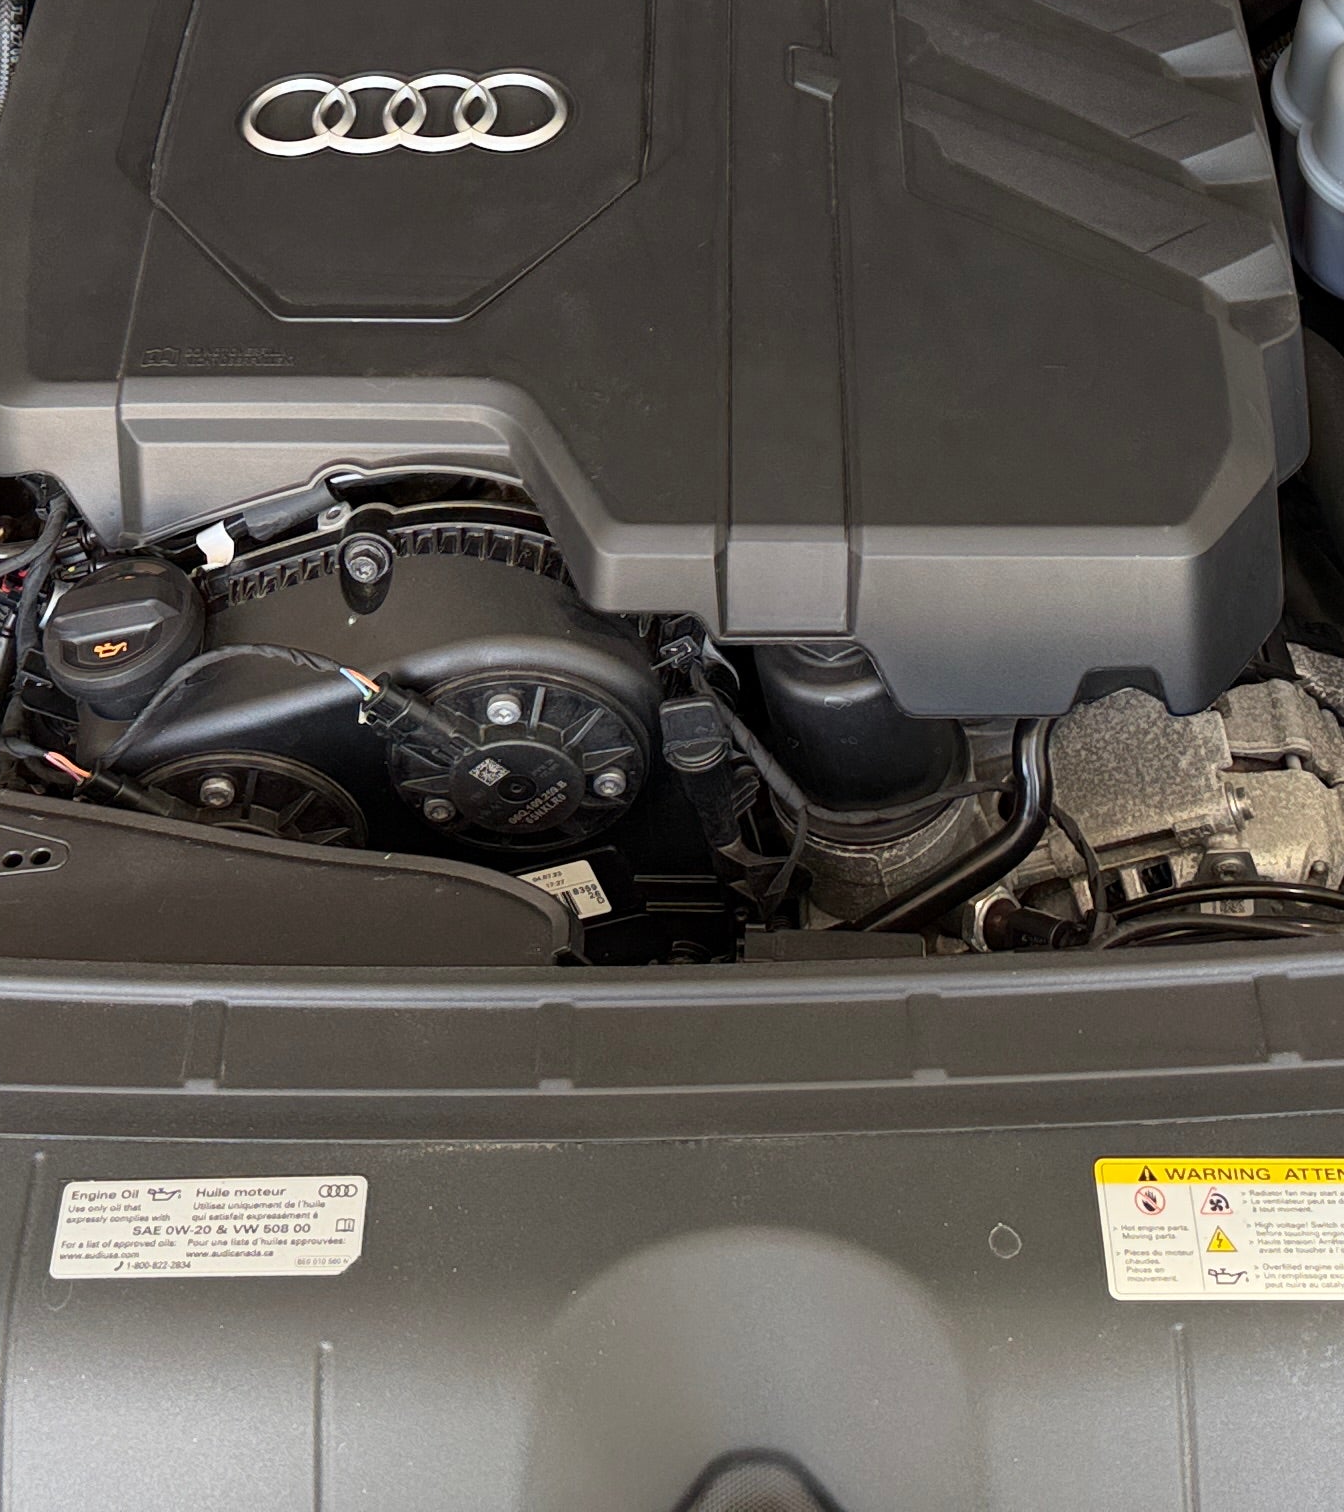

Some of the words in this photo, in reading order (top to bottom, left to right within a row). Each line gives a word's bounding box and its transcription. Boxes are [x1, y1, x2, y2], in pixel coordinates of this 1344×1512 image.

[1164, 1168, 1271, 1180] WARNING
[71, 1190, 117, 1202] Engine
[121, 1189, 139, 1199] Oil
[196, 1188, 230, 1197] Huile
[234, 1188, 286, 1197] moteur
[68, 1204, 85, 1213] Use
[88, 1204, 107, 1213] only
[110, 1204, 121, 1212] oil
[123, 1204, 141, 1212] that
[228, 1201, 282, 1211] uniquement
[284, 1200, 296, 1209] de
[151, 1213, 171, 1222] with
[191, 1213, 206, 1222] qui
[132, 1226, 162, 1236] SAE
[165, 1224, 212, 1236] 0W-20
[216, 1224, 227, 1235] &
[233, 1224, 258, 1234] VW
[263, 1224, 289, 1234] 508
[293, 1224, 311, 1233] 00
[61, 1240, 76, 1249] For
[86, 1240, 100, 1248] list
[102, 1239, 112, 1248] of
[113, 1240, 156, 1249] approved
[187, 1238, 208, 1246] Pour
[230, 1238, 249, 1246] liste
[59, 1250, 140, 1259] www.audiusa.com
[185, 1249, 274, 1258] www.audicanada.ca
